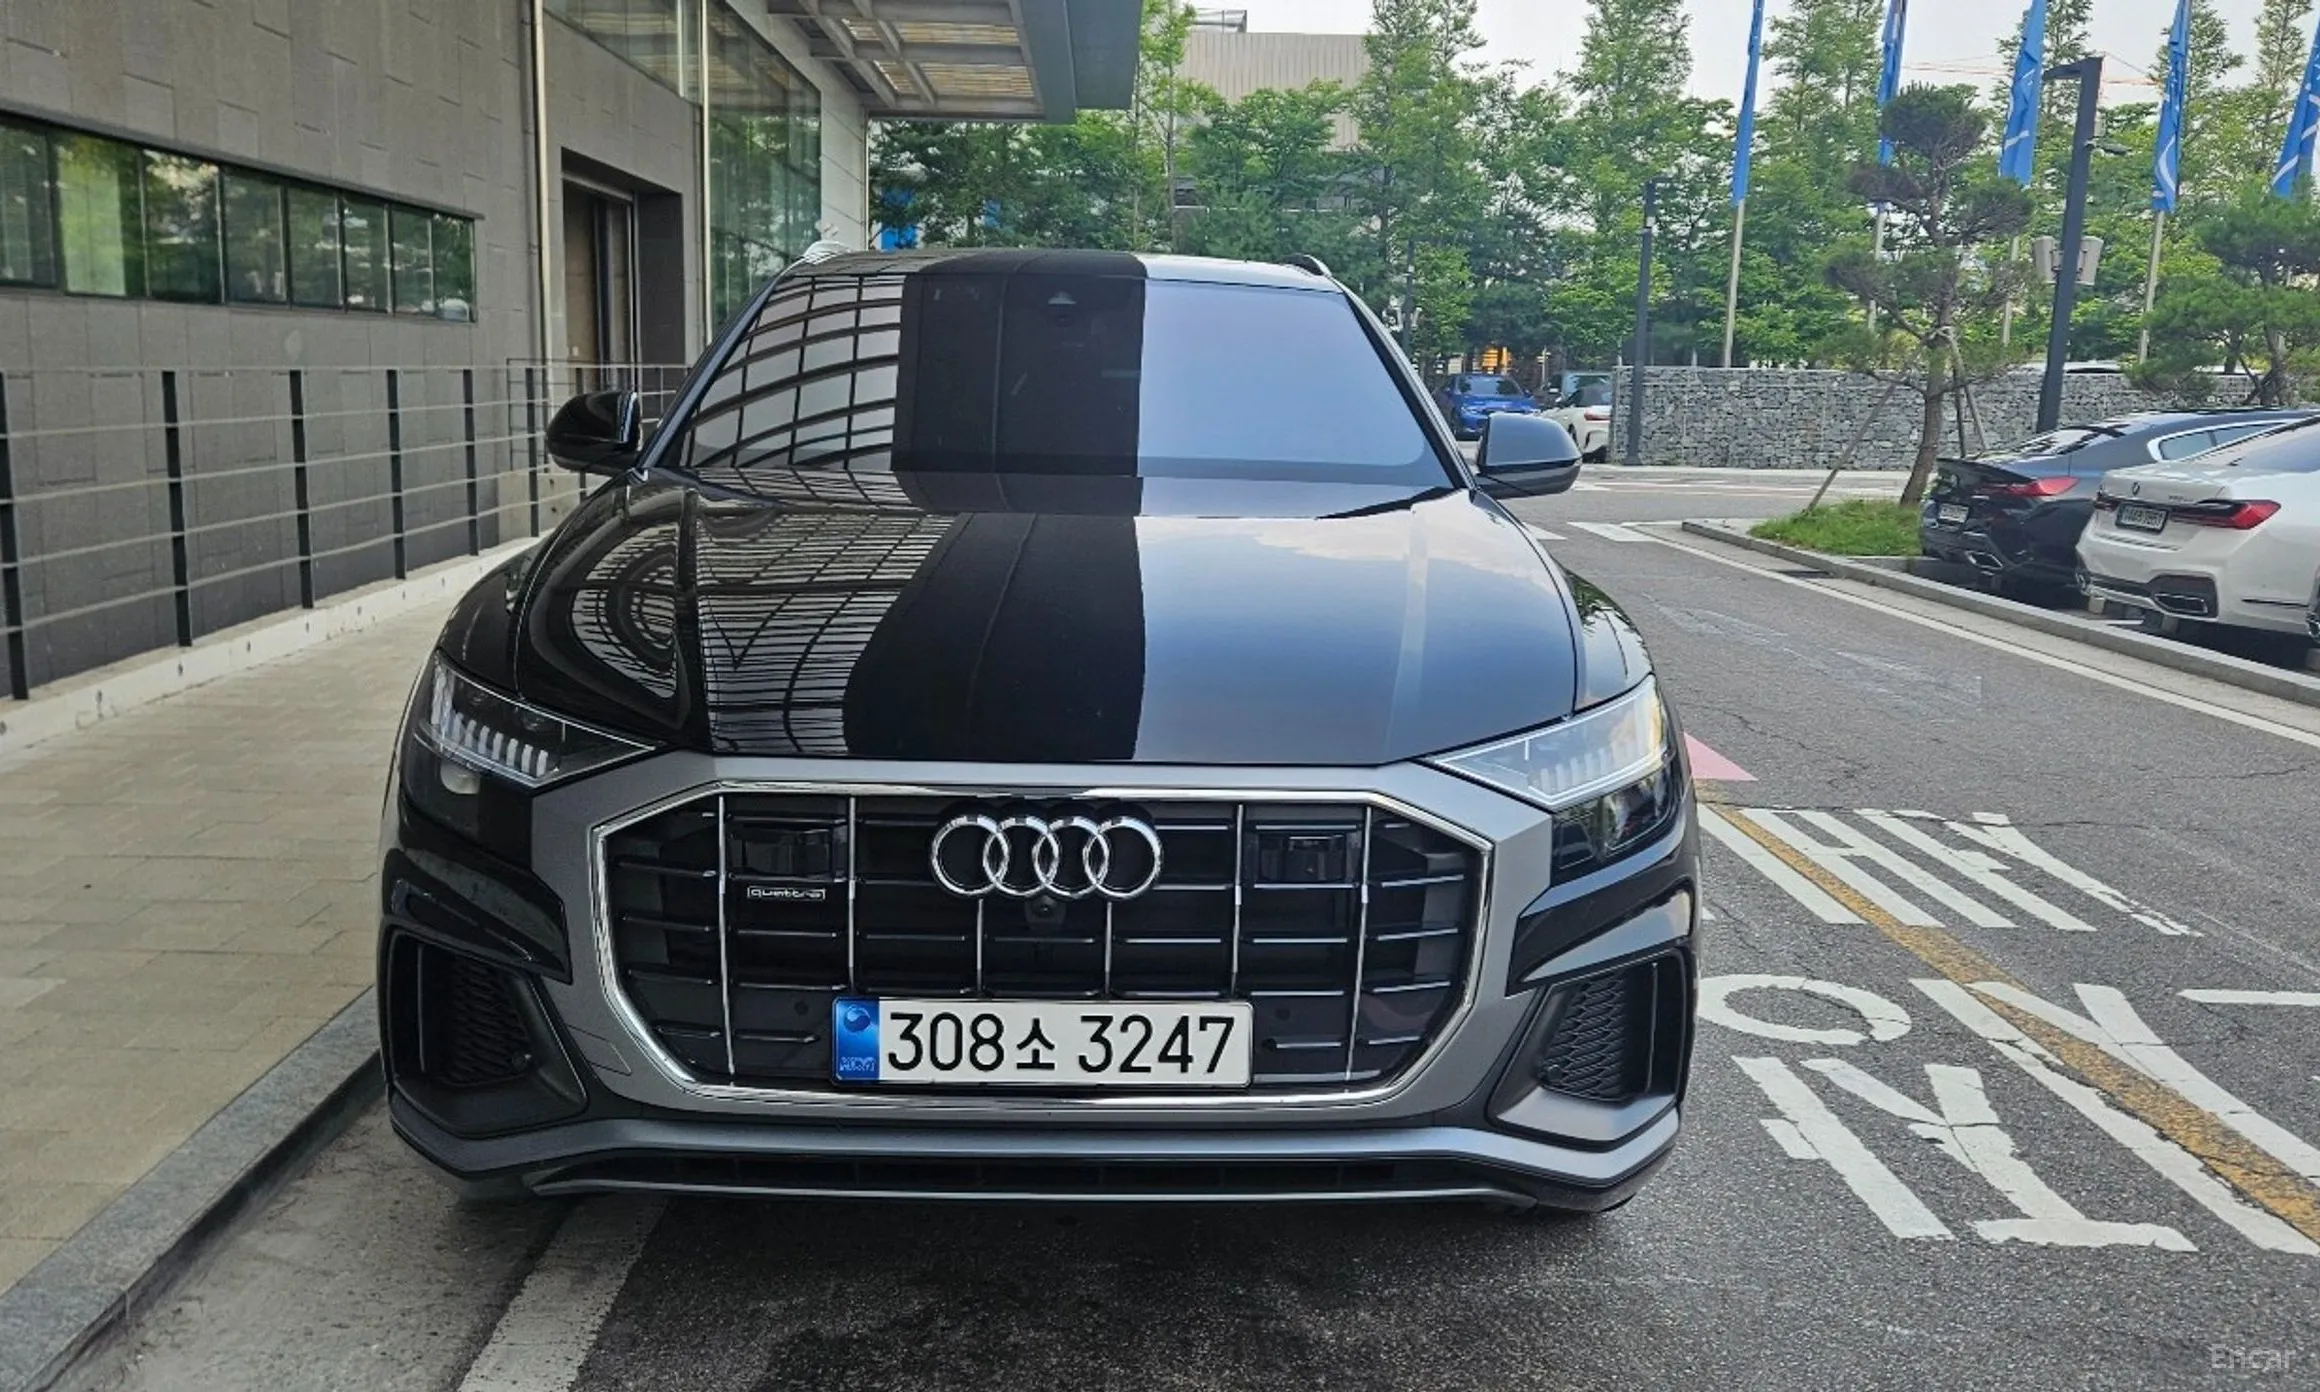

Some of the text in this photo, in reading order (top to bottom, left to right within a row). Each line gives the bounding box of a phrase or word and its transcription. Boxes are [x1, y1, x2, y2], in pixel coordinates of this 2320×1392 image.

[1698, 808, 2204, 937] 서비
[887, 1012, 1235, 1074] 308소 3247
[1698, 973, 2320, 1256] 시장
